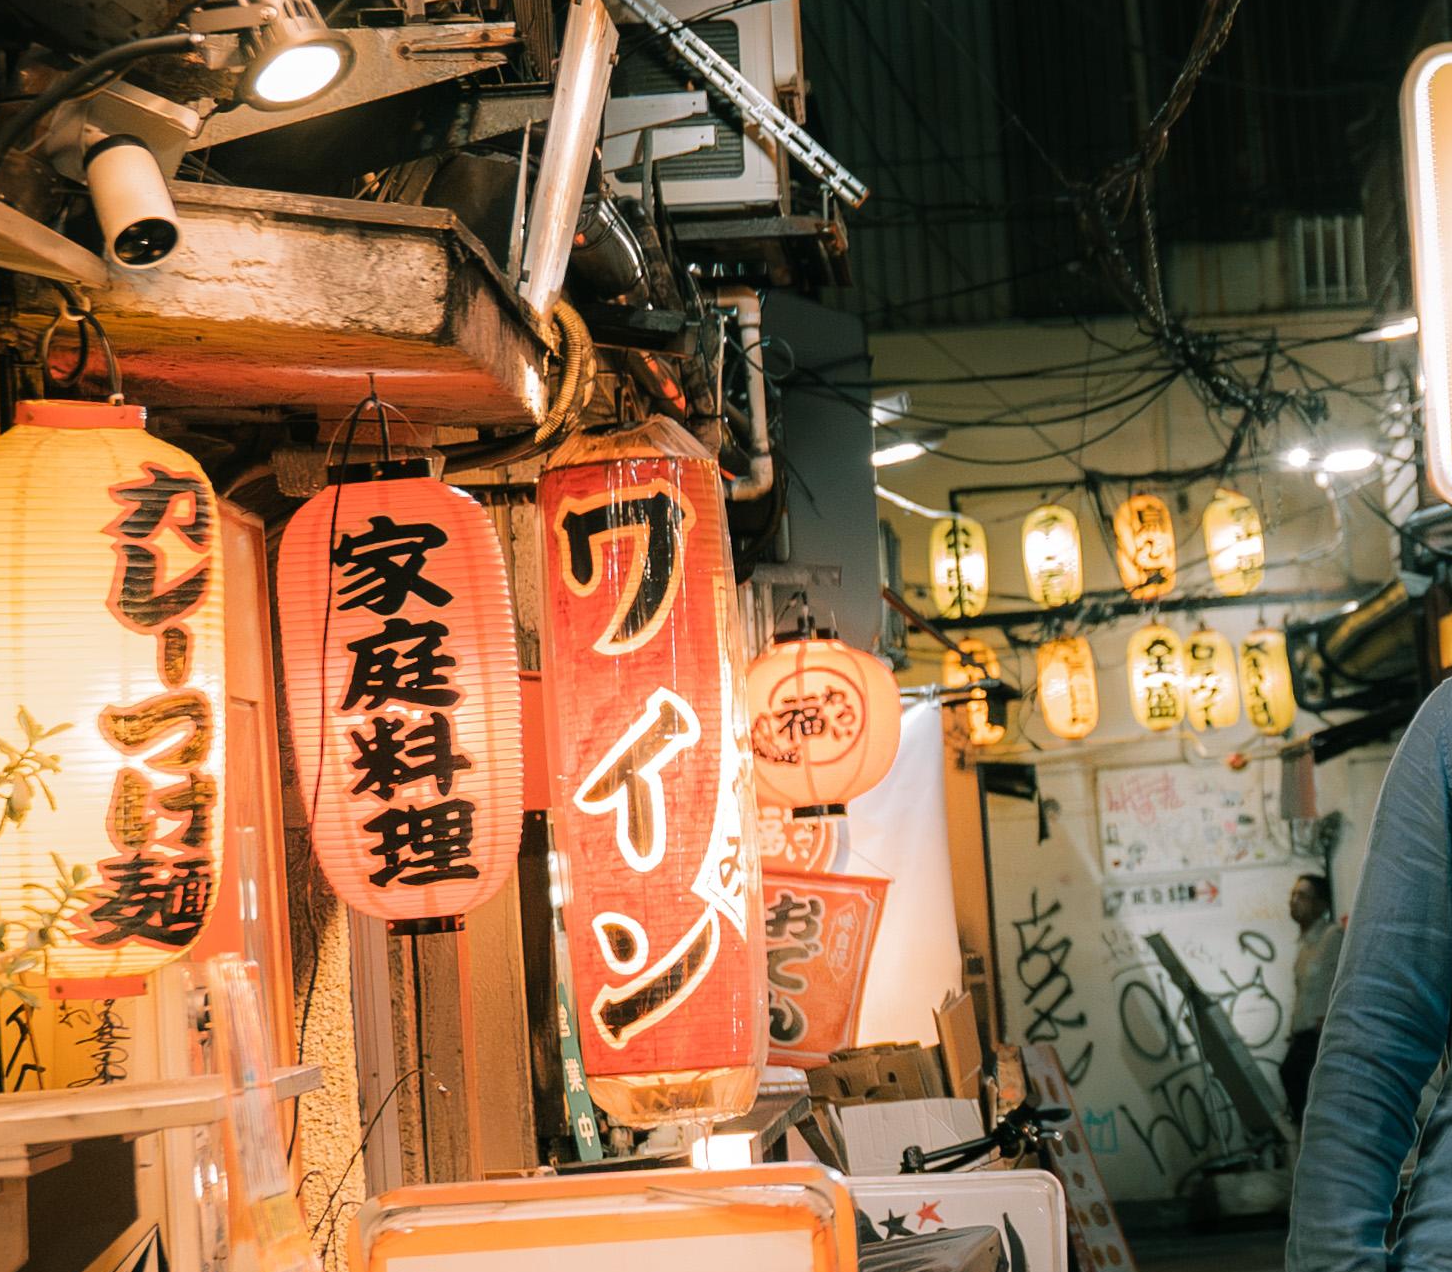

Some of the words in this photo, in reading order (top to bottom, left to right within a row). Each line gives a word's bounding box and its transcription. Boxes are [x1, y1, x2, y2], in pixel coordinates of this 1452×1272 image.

[68, 462, 221, 949] カレーつけ麺
[330, 515, 480, 889] 家庭料理
[553, 477, 726, 1052] ワイン
